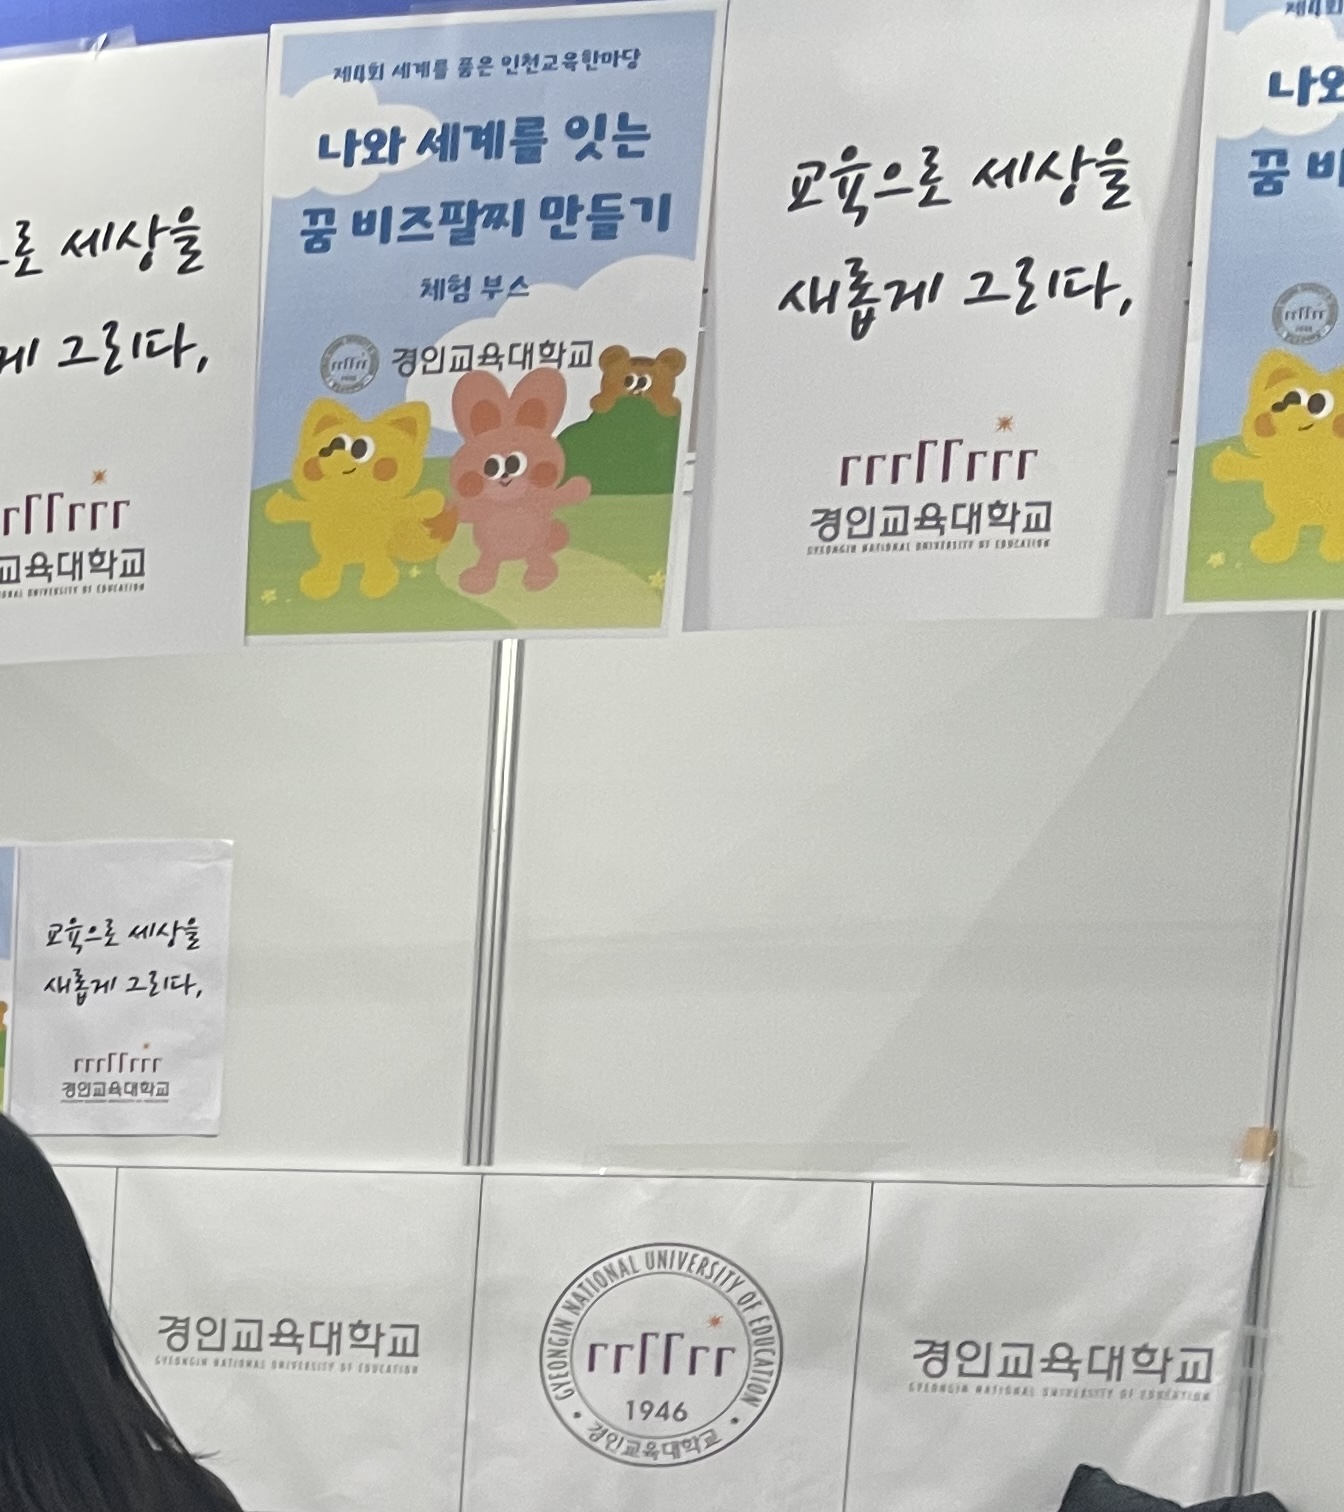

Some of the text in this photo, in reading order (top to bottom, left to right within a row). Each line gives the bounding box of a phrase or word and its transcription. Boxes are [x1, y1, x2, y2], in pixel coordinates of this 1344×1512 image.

[333, 48, 641, 84] 제4회 세계를 품은 인천교육한마당
[319, 112, 651, 168] 나와 세계를 잇는
[788, 138, 1131, 227] 교육으로 세상을
[1248, 149, 1290, 196] 꿈
[61, 206, 203, 275] 세상을
[300, 193, 671, 254] 꿈 비즈팔찌 만들기
[420, 274, 530, 303] 체험 부스
[778, 256, 1132, 341] 새롭게 그리다,
[58, 320, 208, 376] 그리다,
[392, 340, 593, 377] 경인교육대학교
[810, 500, 1052, 542] 경인교육대학교
[46, 917, 199, 955] 교육으로 세상을
[44, 968, 202, 1006] 새롭게 그리다,
[62, 1081, 169, 1098] 경인교육대학교
[158, 1316, 419, 1358] 경인교육대학교
[548, 1250, 776, 1408] GYEONGIN NATIONAL UNIVERSITY OF EDUCATION
[913, 1339, 1214, 1384] 경인교육대학교
[626, 1400, 688, 1422] 1946
[588, 1421, 723, 1460] 경인교육대학교
